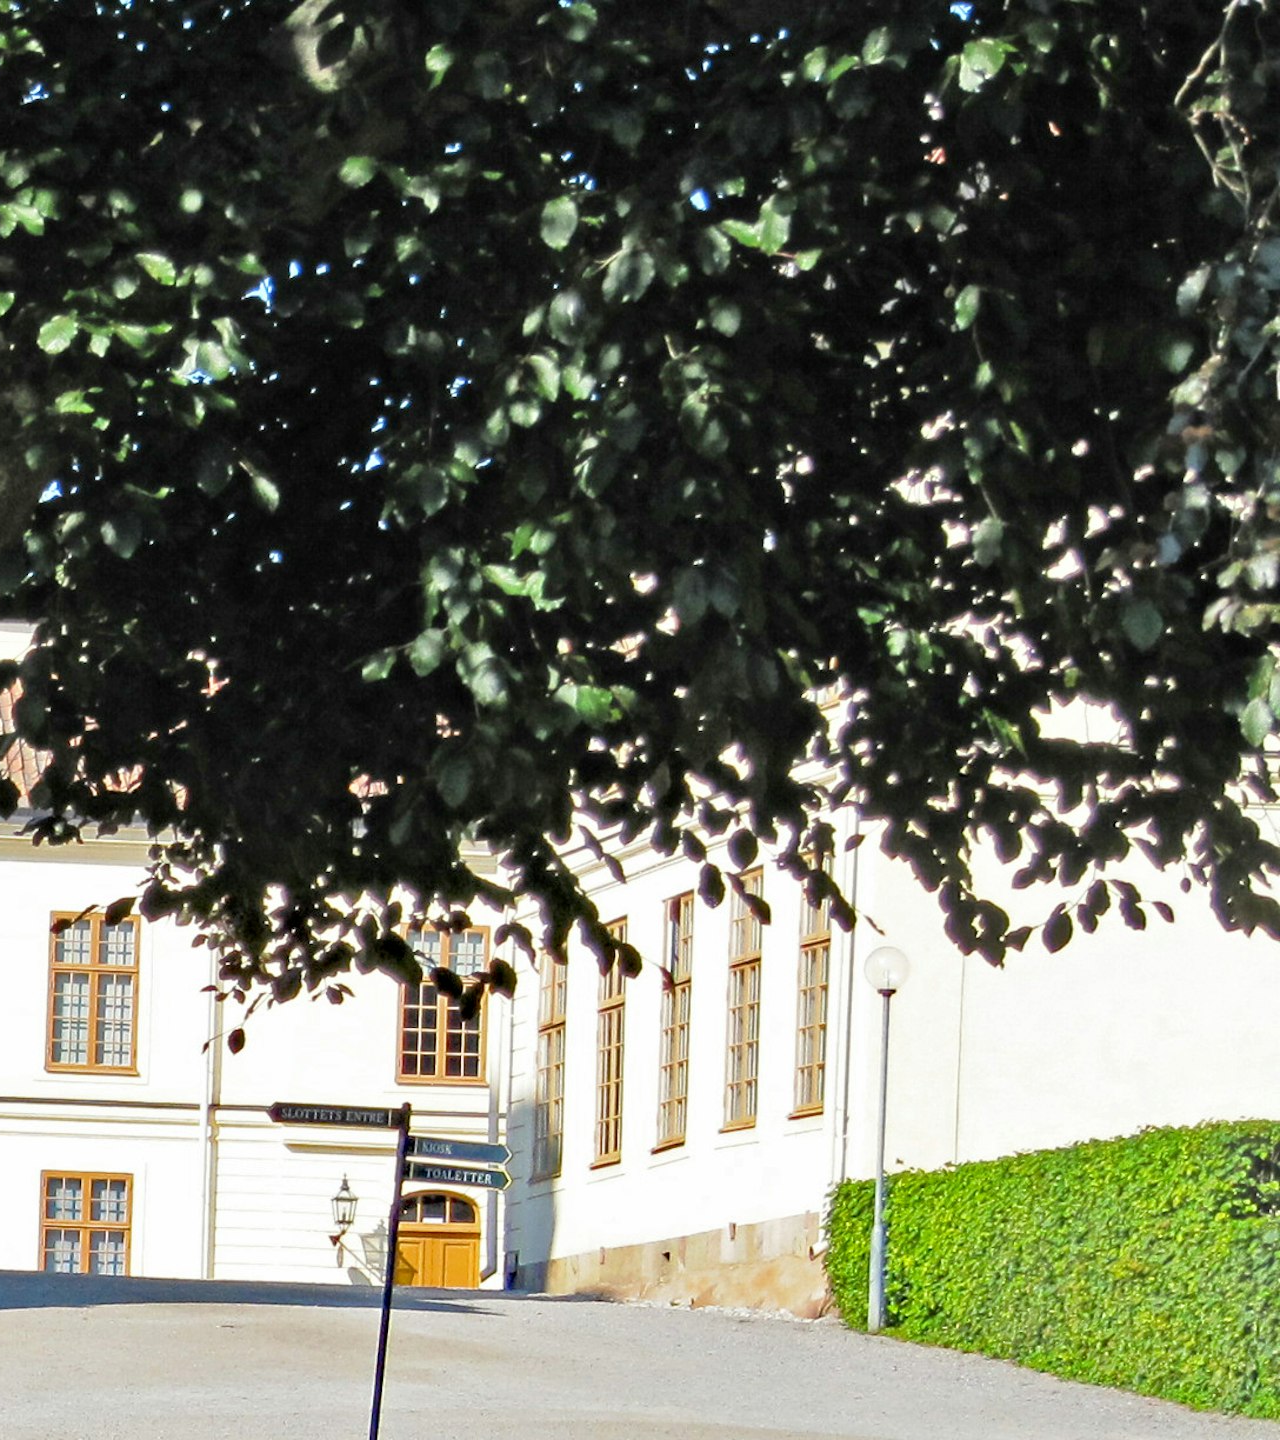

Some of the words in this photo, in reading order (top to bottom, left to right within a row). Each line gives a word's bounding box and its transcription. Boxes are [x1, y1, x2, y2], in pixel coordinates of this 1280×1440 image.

[281, 1107, 342, 1121] SLOTTETS
[422, 1141, 452, 1155] KIOSK
[425, 1168, 492, 1185] TOALETTER
